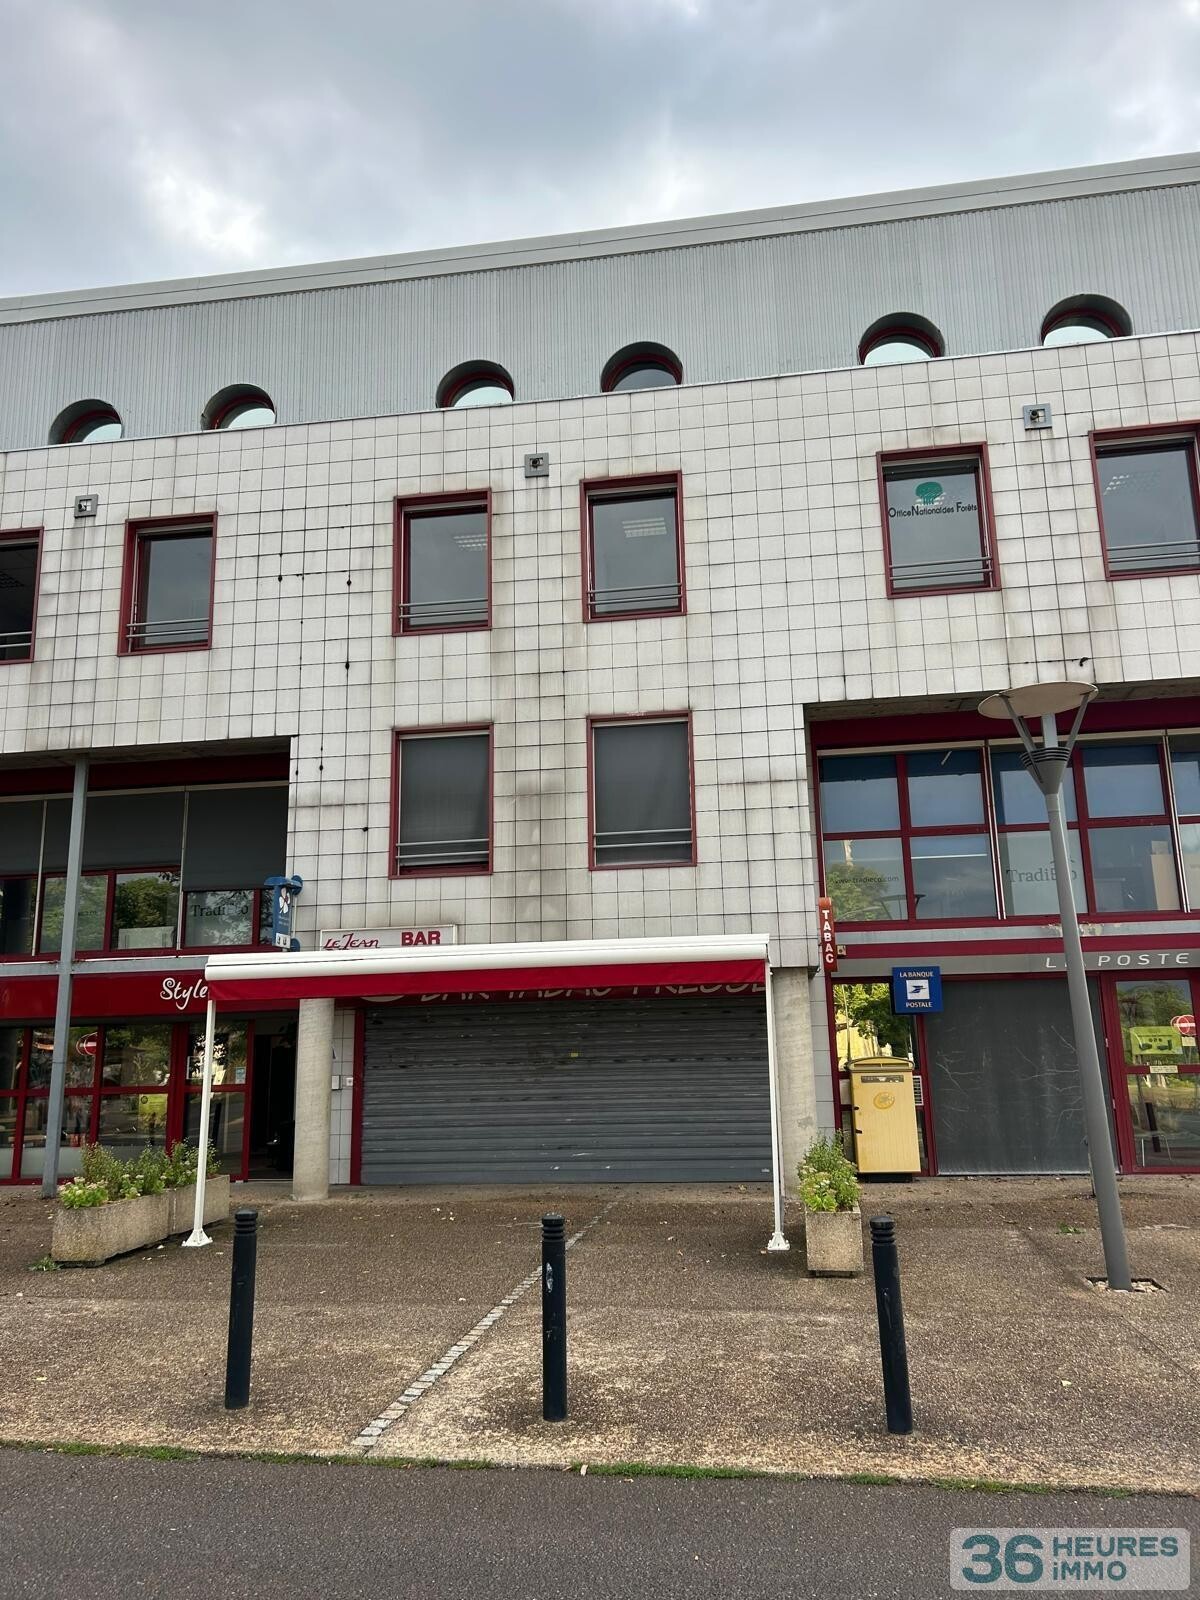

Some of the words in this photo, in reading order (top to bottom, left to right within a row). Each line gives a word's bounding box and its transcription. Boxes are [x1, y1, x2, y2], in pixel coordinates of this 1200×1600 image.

[1006, 867, 1078, 883] TradiEo
[401, 930, 441, 947] BAR
[822, 909, 834, 964] TABAC
[1098, 952, 1190, 968] POSTE
[160, 977, 208, 1010] Style
